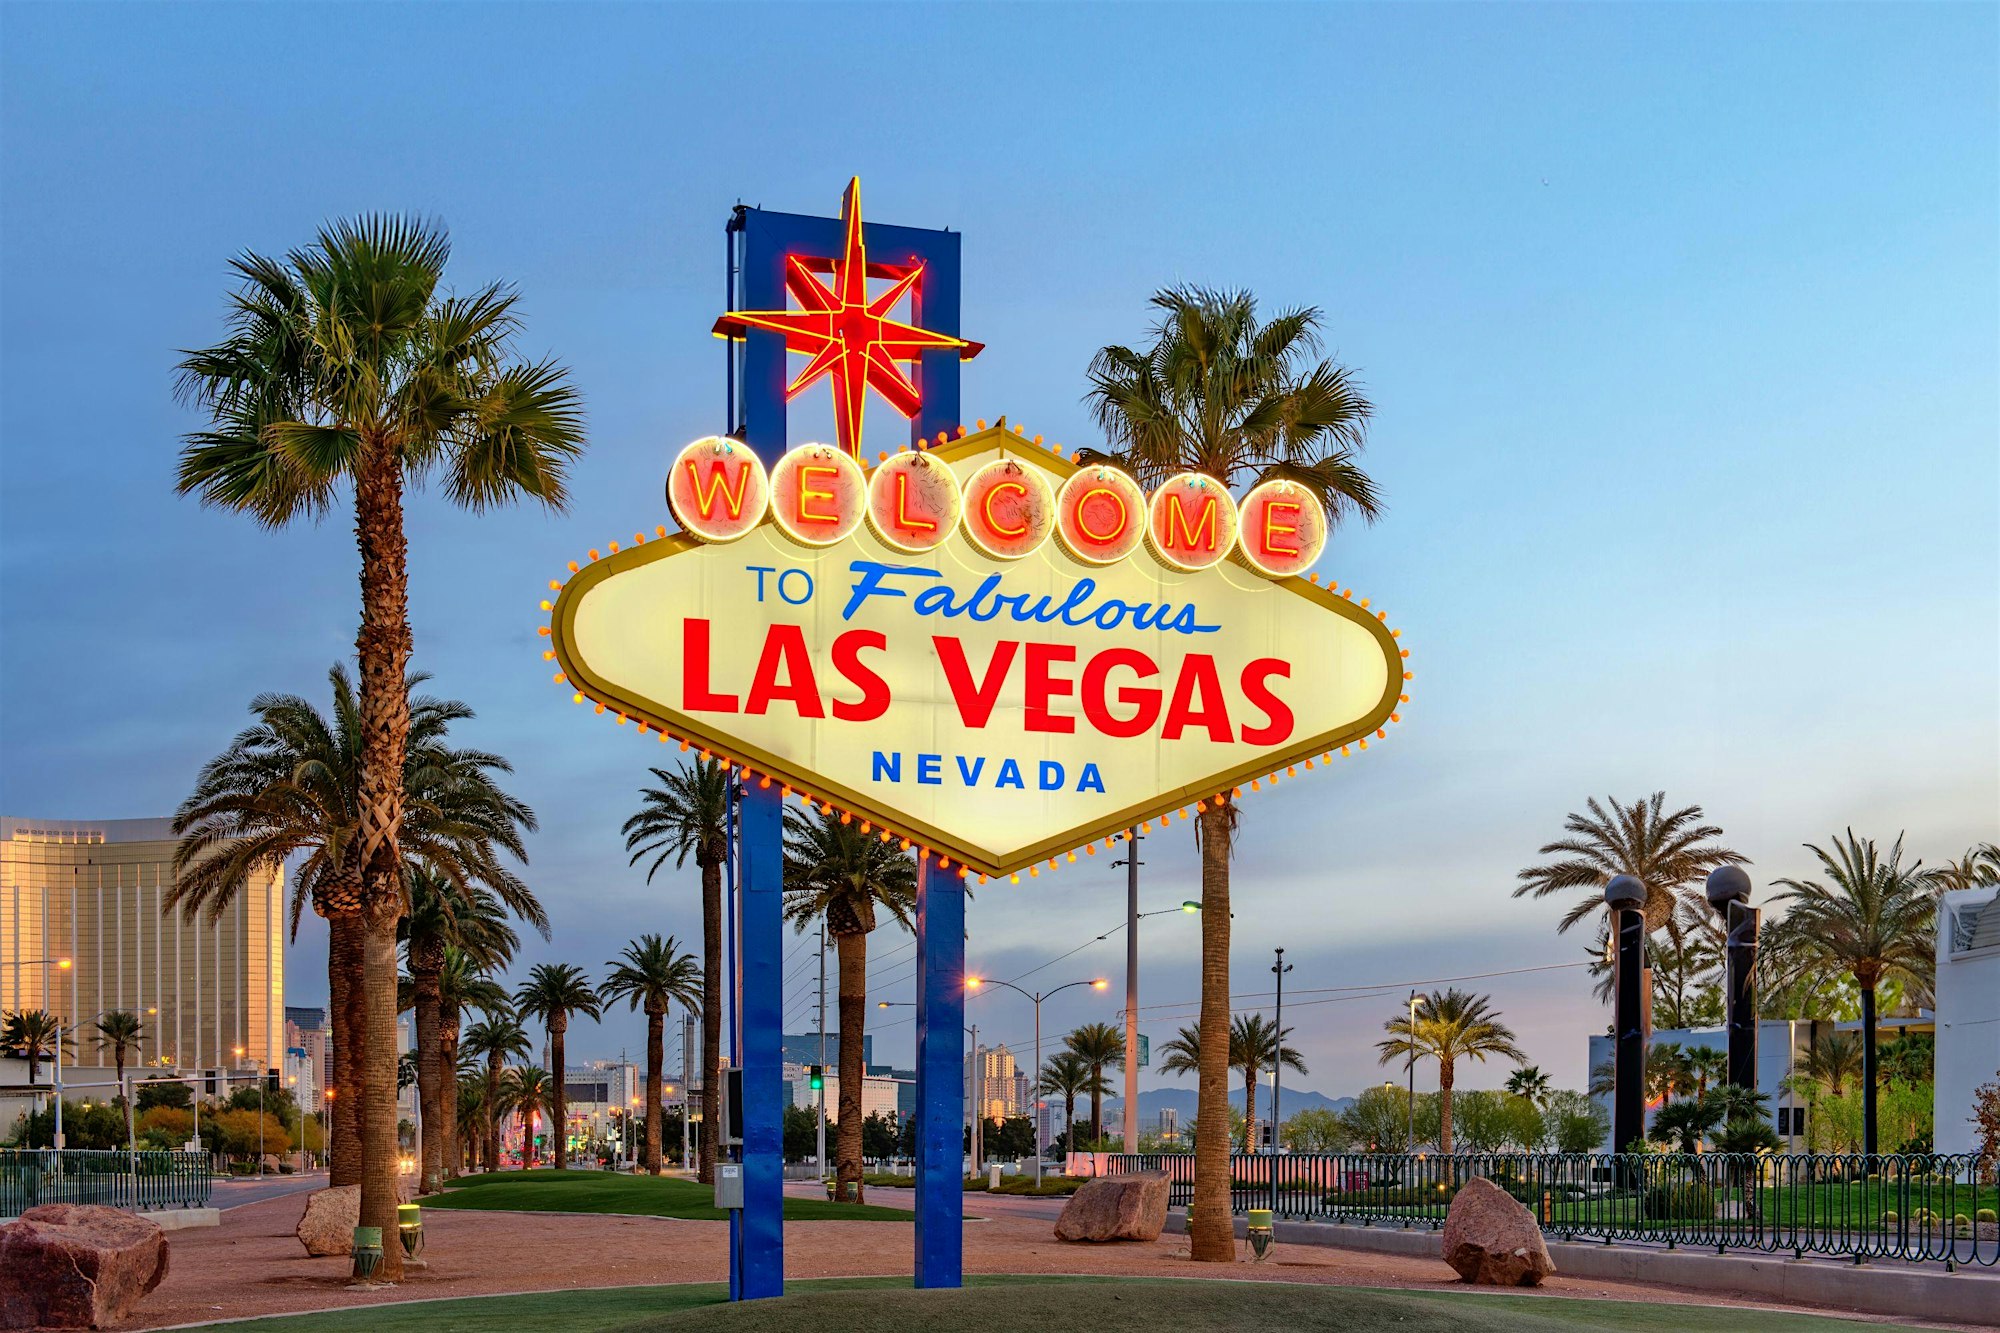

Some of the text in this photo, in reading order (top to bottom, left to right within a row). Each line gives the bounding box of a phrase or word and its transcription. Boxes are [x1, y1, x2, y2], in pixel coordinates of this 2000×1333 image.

[683, 459, 1300, 557] WELCOME
[747, 560, 1221, 635] TO Fabulous
[682, 617, 1295, 747] LAS VEGAS
[872, 751, 1105, 793] NEVADA
